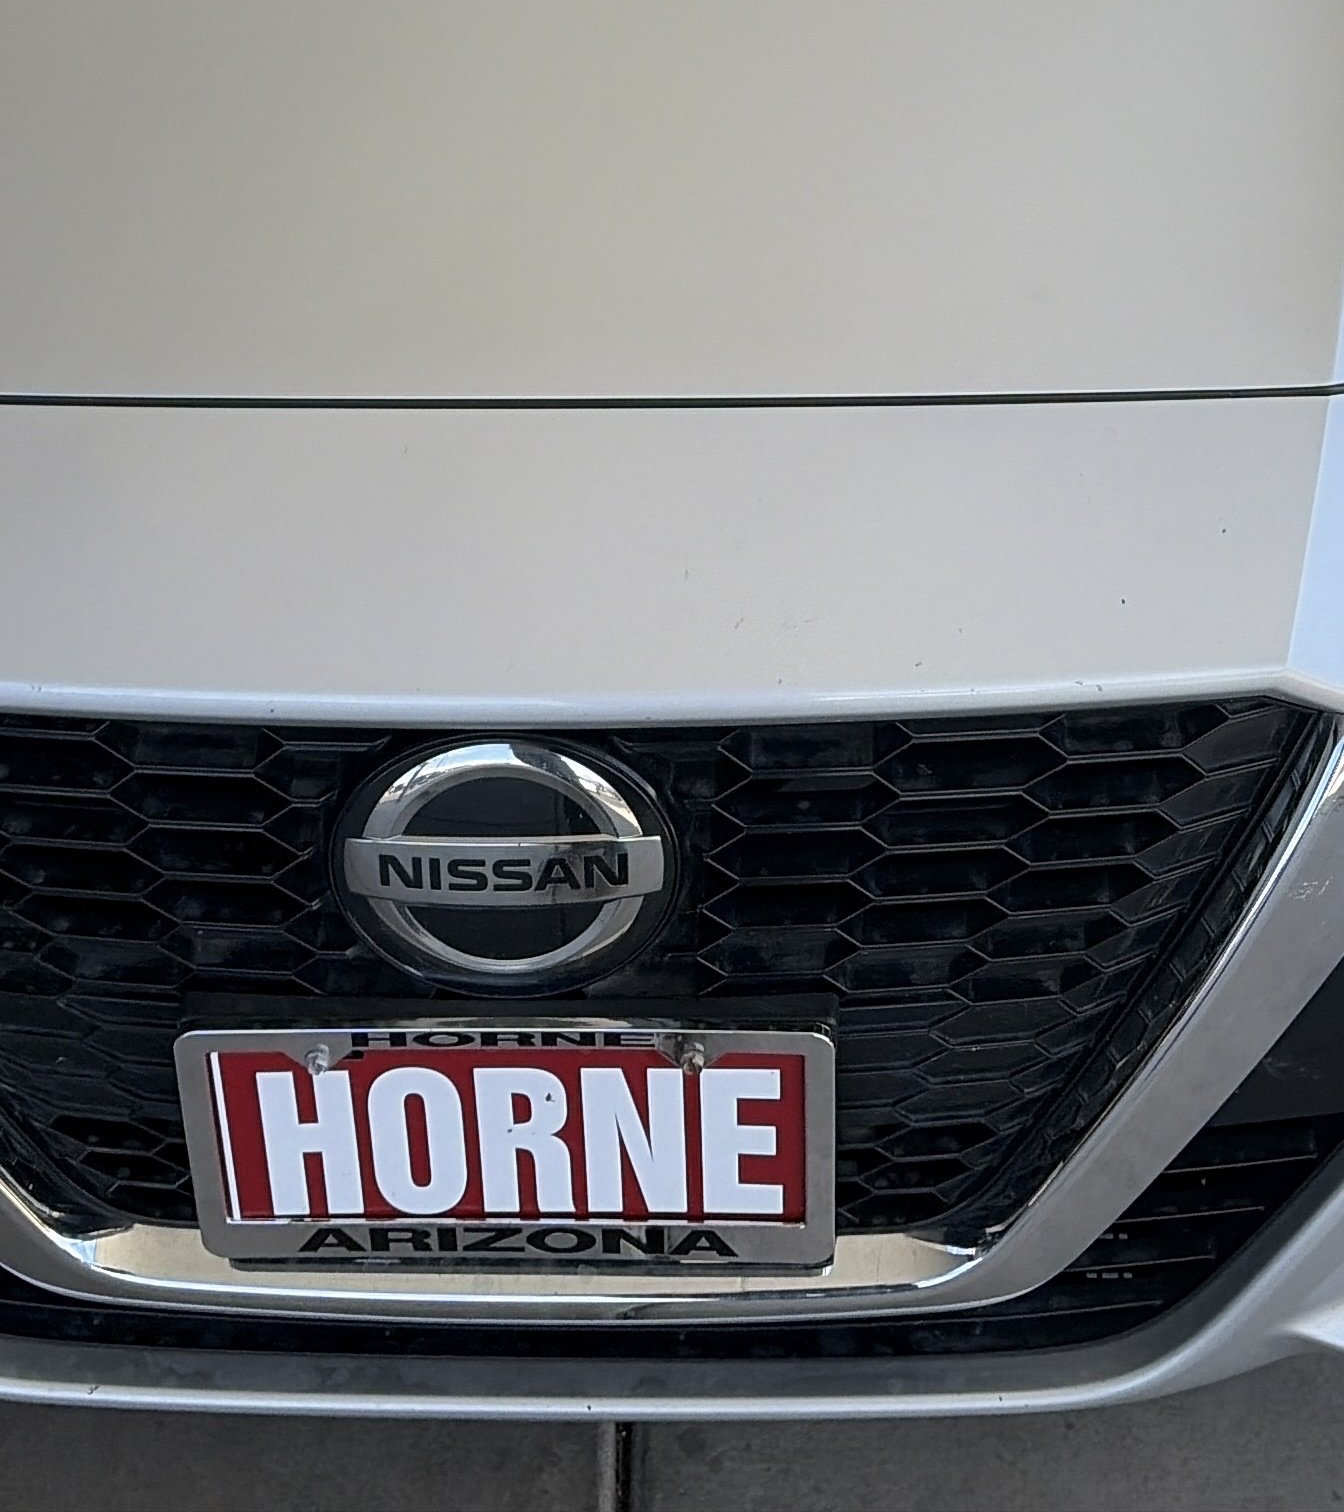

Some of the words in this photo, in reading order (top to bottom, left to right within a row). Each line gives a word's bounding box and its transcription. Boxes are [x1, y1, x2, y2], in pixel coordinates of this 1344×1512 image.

[378, 853, 629, 892] NISSAN
[351, 1032, 656, 1047] HORNE
[256, 1066, 784, 1216] HORNE
[298, 1227, 739, 1257] ARIZONA
